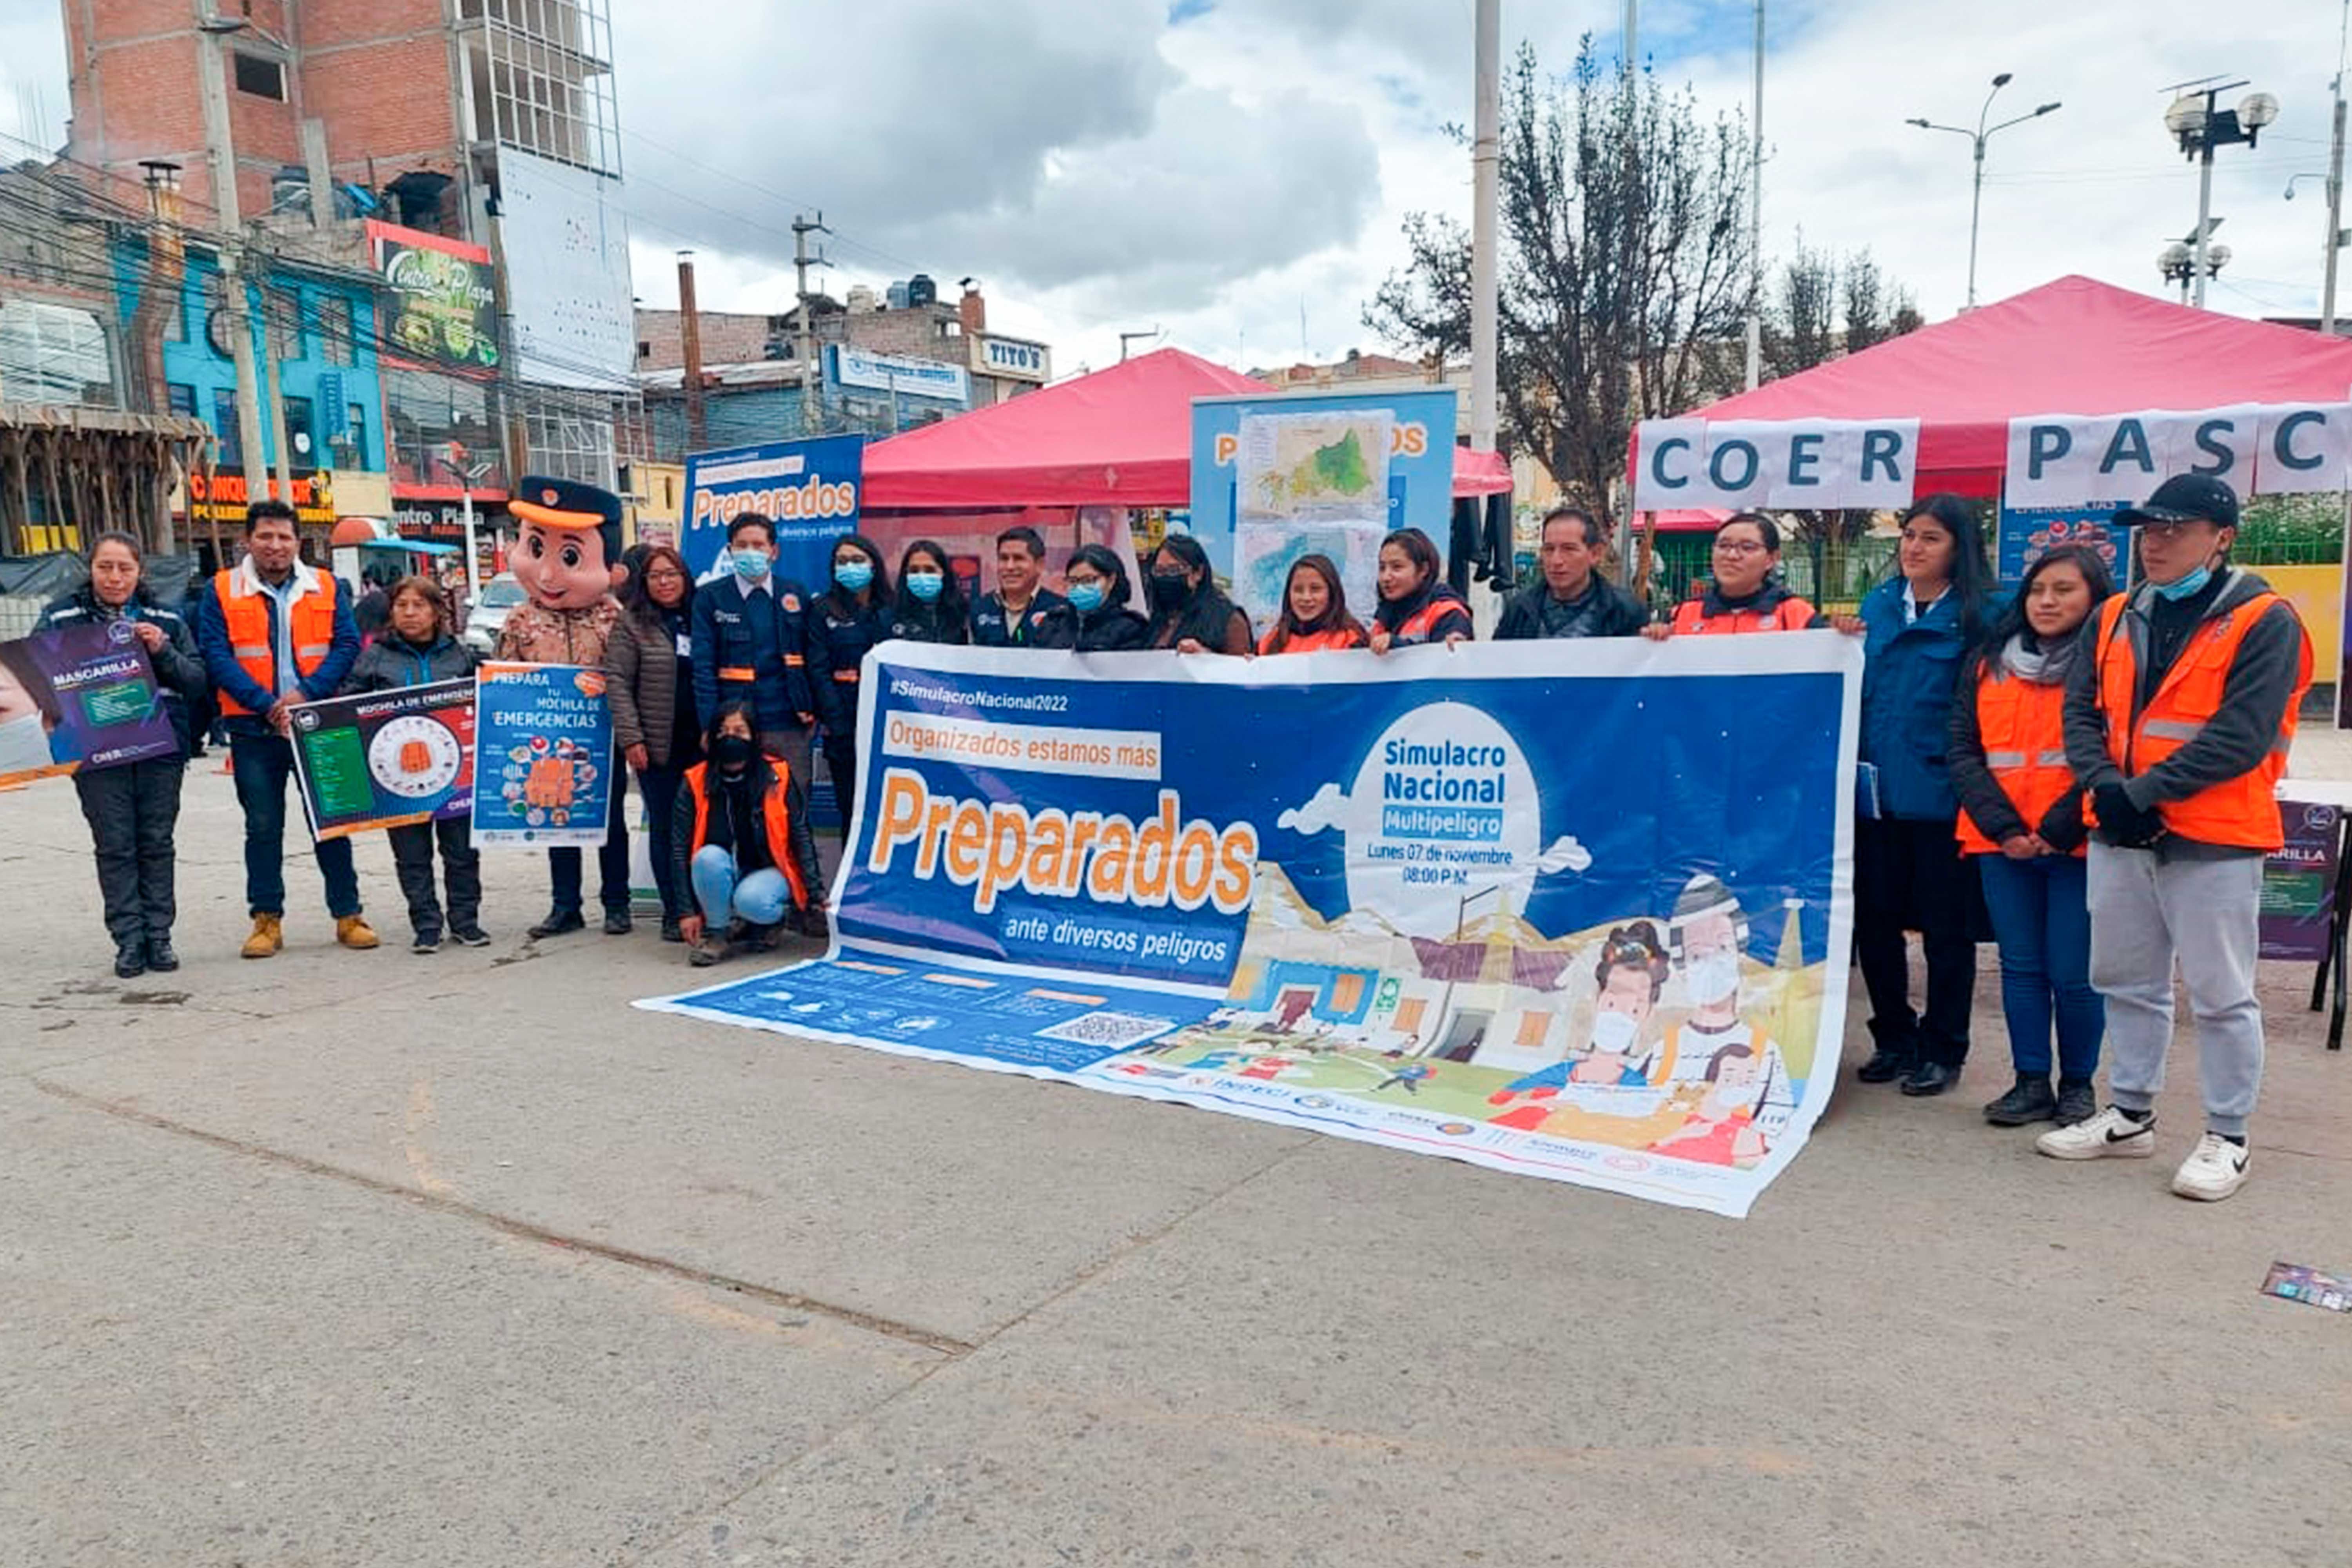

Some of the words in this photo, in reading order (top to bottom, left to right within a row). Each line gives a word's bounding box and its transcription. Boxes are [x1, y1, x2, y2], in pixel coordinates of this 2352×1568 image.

[991, 343, 1040, 369] TITO'S
[1652, 429, 1903, 491] COER
[443, 507, 484, 525] Plaa
[691, 473, 855, 530] Preparados
[53, 659, 140, 686] MASCARILLA
[492, 672, 550, 686] PREPARA
[537, 698, 585, 711] MOCHILA
[890, 680, 1068, 711] #SimulacroNacional2022
[494, 711, 597, 728] EMERGENCIAS
[890, 720, 1020, 758] Organizados
[1028, 739, 1111, 765] estamos
[1117, 739, 1157, 768] más
[1385, 739, 1505, 768] Simulacro
[1384, 770, 1504, 803] Nacional
[1384, 808, 1501, 840] Multipeligro
[869, 768, 1259, 915] Preparados
[1368, 843, 1404, 860] Lunes
[1407, 846, 1423, 860] 07
[1426, 847, 1442, 862] de
[1445, 848, 1513, 865] noviembre
[1403, 867, 1439, 883] 08:00
[1006, 919, 1047, 942] ante
[1053, 920, 1136, 951] diversos
[1141, 932, 1226, 964] peligros
